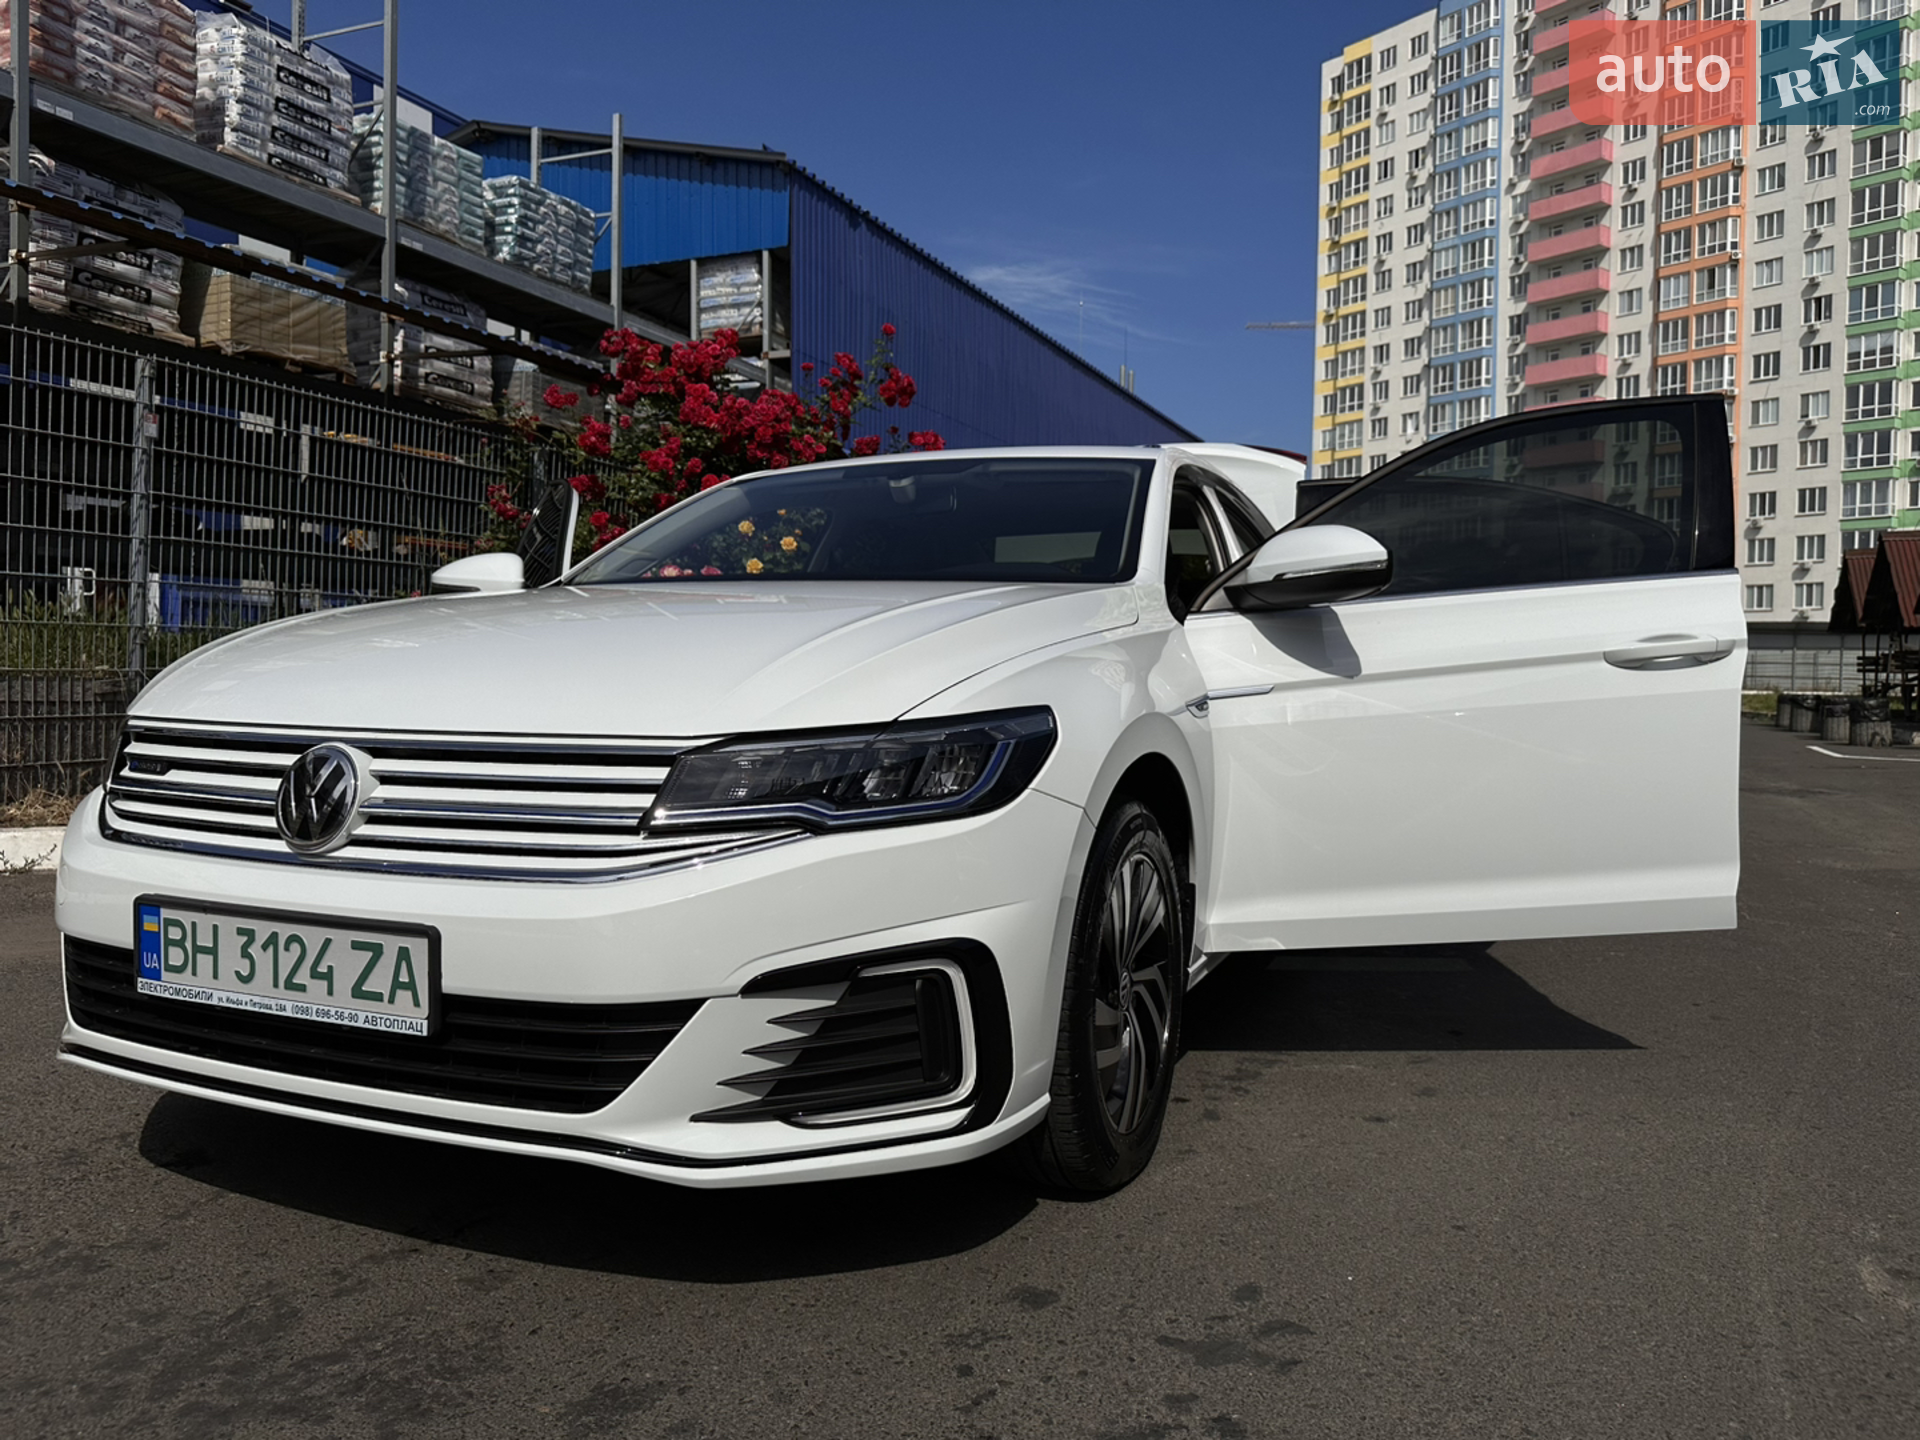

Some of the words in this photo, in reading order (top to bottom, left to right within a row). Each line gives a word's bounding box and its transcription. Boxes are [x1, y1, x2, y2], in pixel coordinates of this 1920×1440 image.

[76, 271, 149, 303] Ceresit
[143, 951, 160, 969] UA
[163, 916, 219, 980] BH
[234, 926, 334, 997] 3124
[350, 939, 421, 1008] ZA
[138, 980, 214, 1002] ЭЛЕКТРОМОБИЛИ
[291, 1003, 314, 1018] (098)
[315, 1006, 359, 1024] 696-56-90
[363, 1014, 423, 1034] АВТОПЛАЦ
